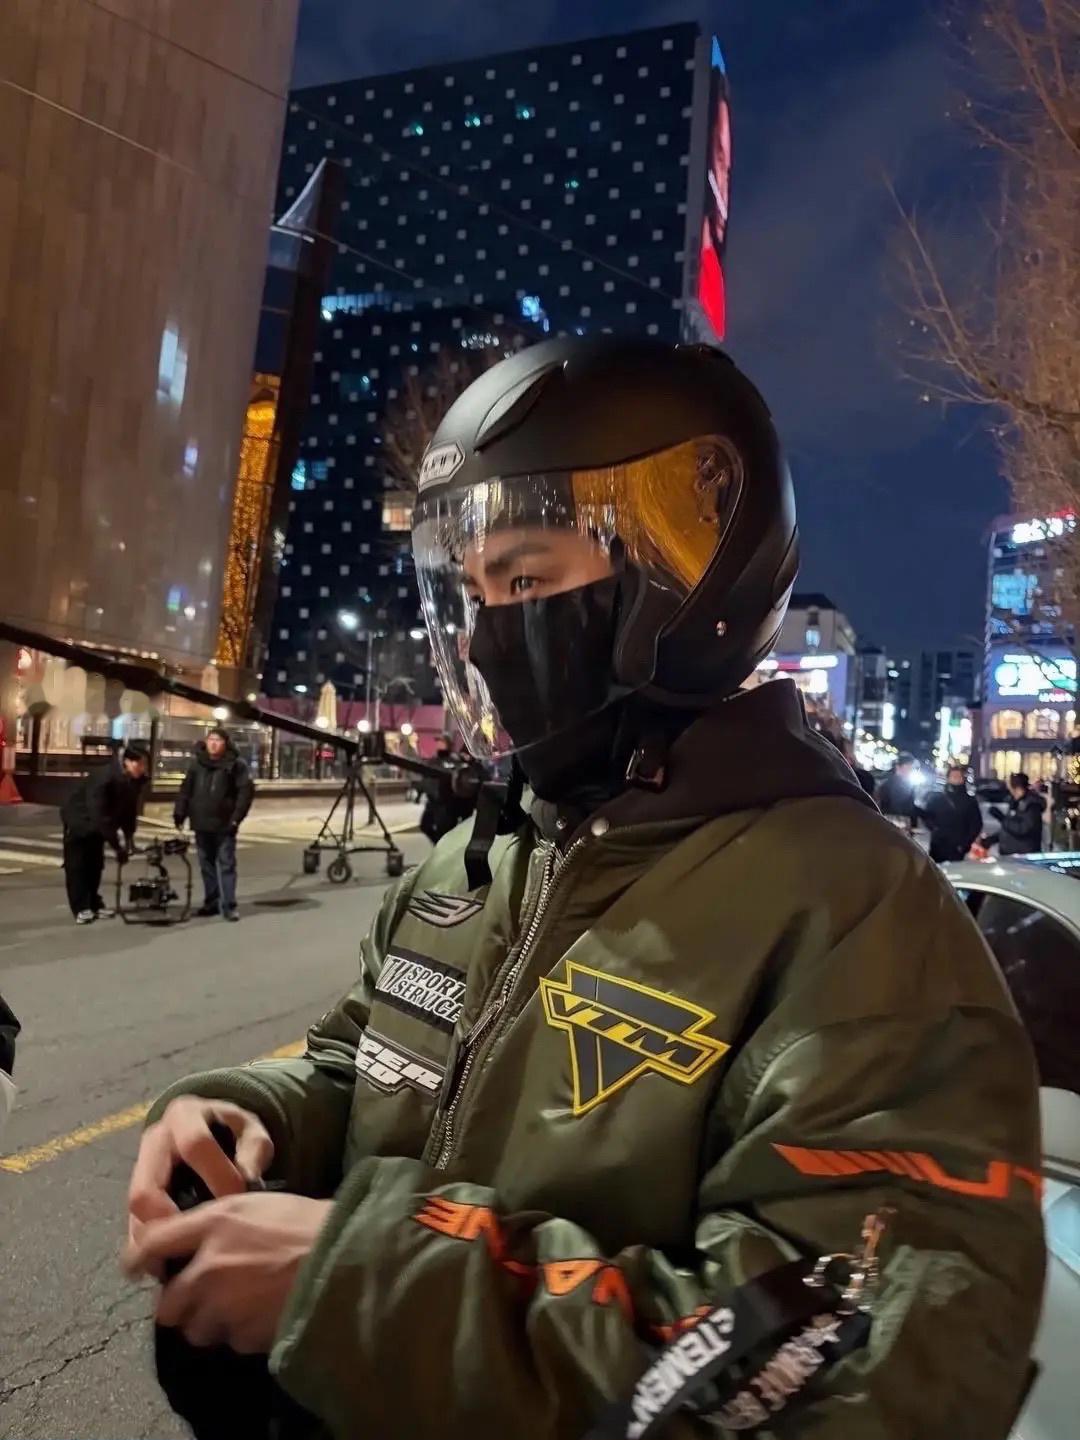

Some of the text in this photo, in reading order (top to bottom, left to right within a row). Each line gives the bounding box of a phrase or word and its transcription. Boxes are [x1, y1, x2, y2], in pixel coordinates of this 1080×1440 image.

[392, 978, 465, 1024] SERVICE
[405, 962, 467, 998] SPORT
[550, 994, 704, 1068] VTM
[357, 1033, 444, 1090] PER
